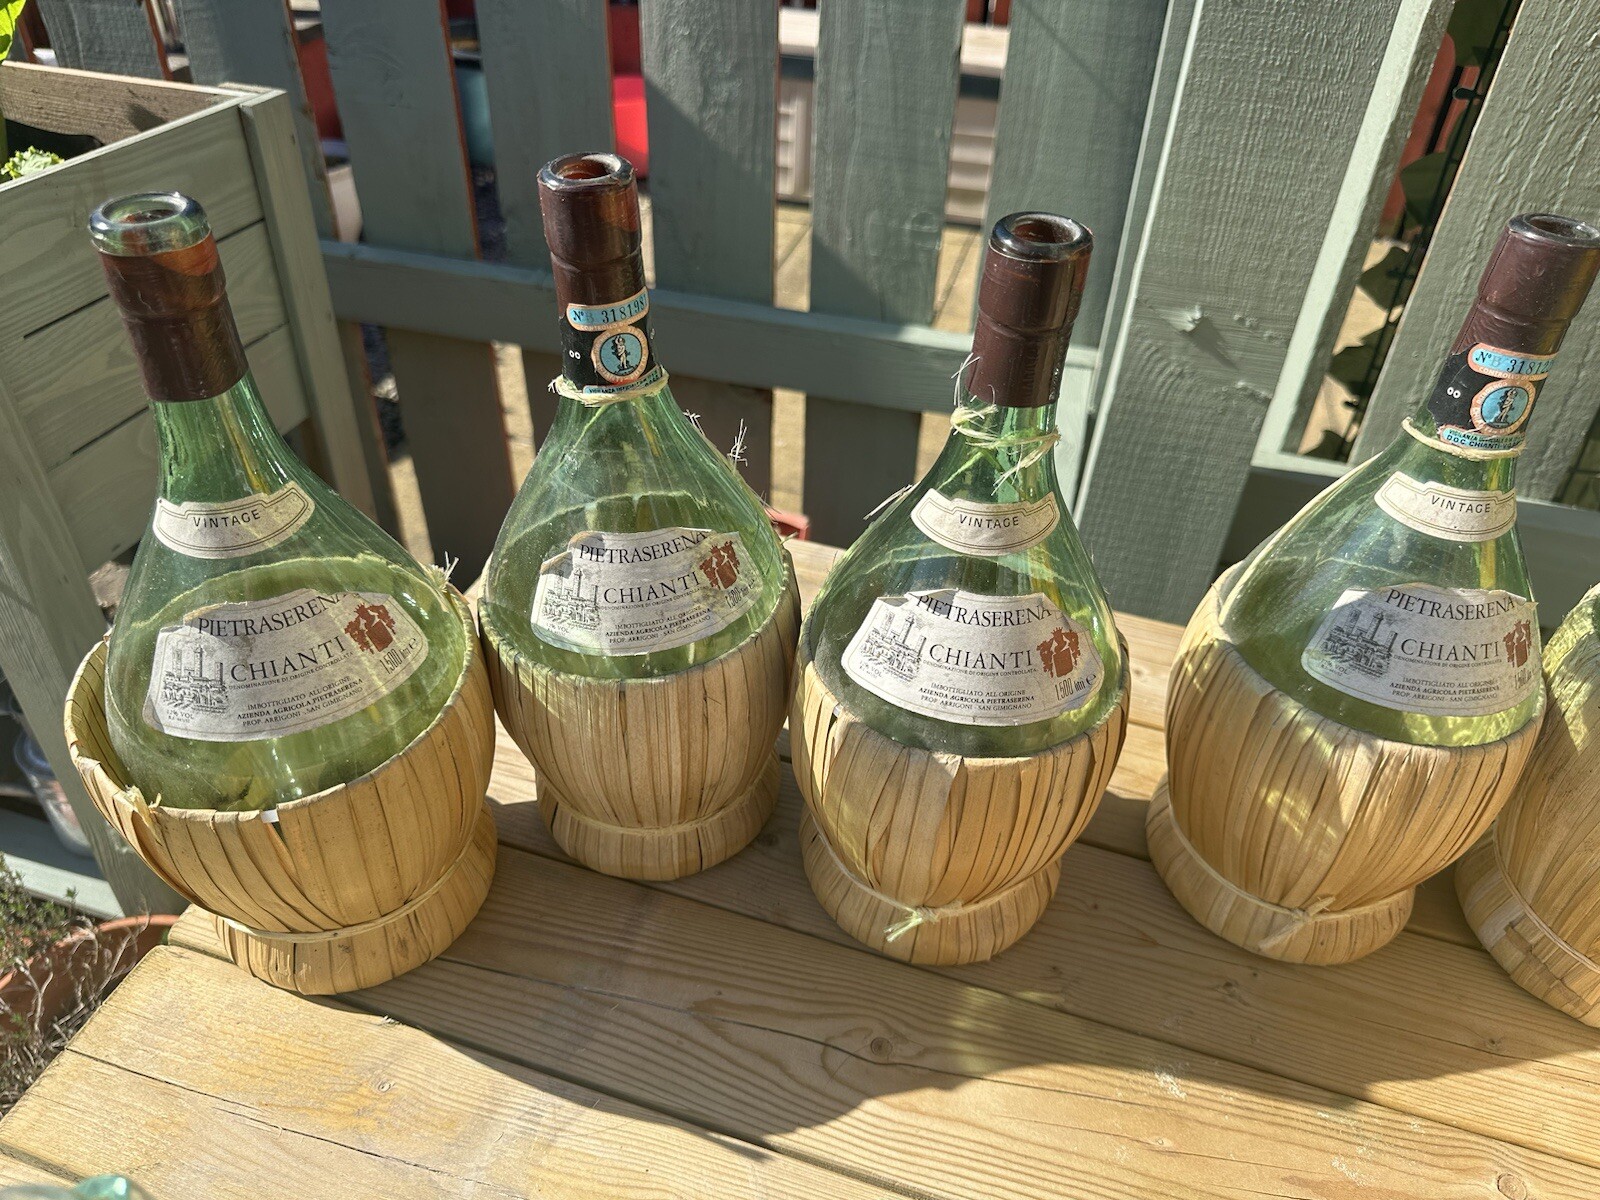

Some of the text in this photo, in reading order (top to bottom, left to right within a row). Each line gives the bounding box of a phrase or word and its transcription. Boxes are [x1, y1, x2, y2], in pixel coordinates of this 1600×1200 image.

[1478, 366, 1520, 380] CONTROLLO
[1430, 494, 1492, 514] VINTAGE
[192, 508, 261, 529] VINTAGE
[959, 514, 1020, 530] VINTAGE
[579, 531, 708, 564] PIETRASERENA
[603, 571, 700, 604] CHIANTI
[916, 594, 1052, 628] PIETRASERENA
[1385, 588, 1516, 621] PIETRASERENA
[605, 607, 711, 637] AZIENDA AGRICOLA PIETRASERENA
[614, 618, 664, 630] IMBOTTIGLIATO
[230, 635, 346, 682] CHIANTI
[929, 643, 1032, 670] CHIANTI
[1401, 638, 1500, 662] CHIANTI
[922, 660, 967, 675] DENOMINAZIONE
[999, 668, 1037, 676] CONTROLLATA
[1393, 654, 1440, 667] DENOMINAZIONE
[228, 678, 281, 690] DENOMINAZIONE
[289, 669, 314, 681] ORIGINE
[315, 651, 353, 672] CONTROLLATA
[931, 682, 983, 697] IMBOTTIGLIATO
[1389, 682, 1500, 696] AZIENDA AGRICOLA PIETRASERENA
[1402, 677, 1455, 689] IMBOTTIGLIATO
[237, 678, 363, 720] AZIENDA AGRICOLA PIETRASERENA
[247, 693, 306, 711] IMBOTTIGLIATO
[919, 687, 1035, 705] AZIENDA AGRICOLA PIETRASERENA
[1412, 693, 1445, 701] ARRIGONI
[939, 699, 973, 711] ARRIGONI
[992, 702, 1032, 712] GIMIGNANO
[264, 711, 301, 724] ARRIGONI
